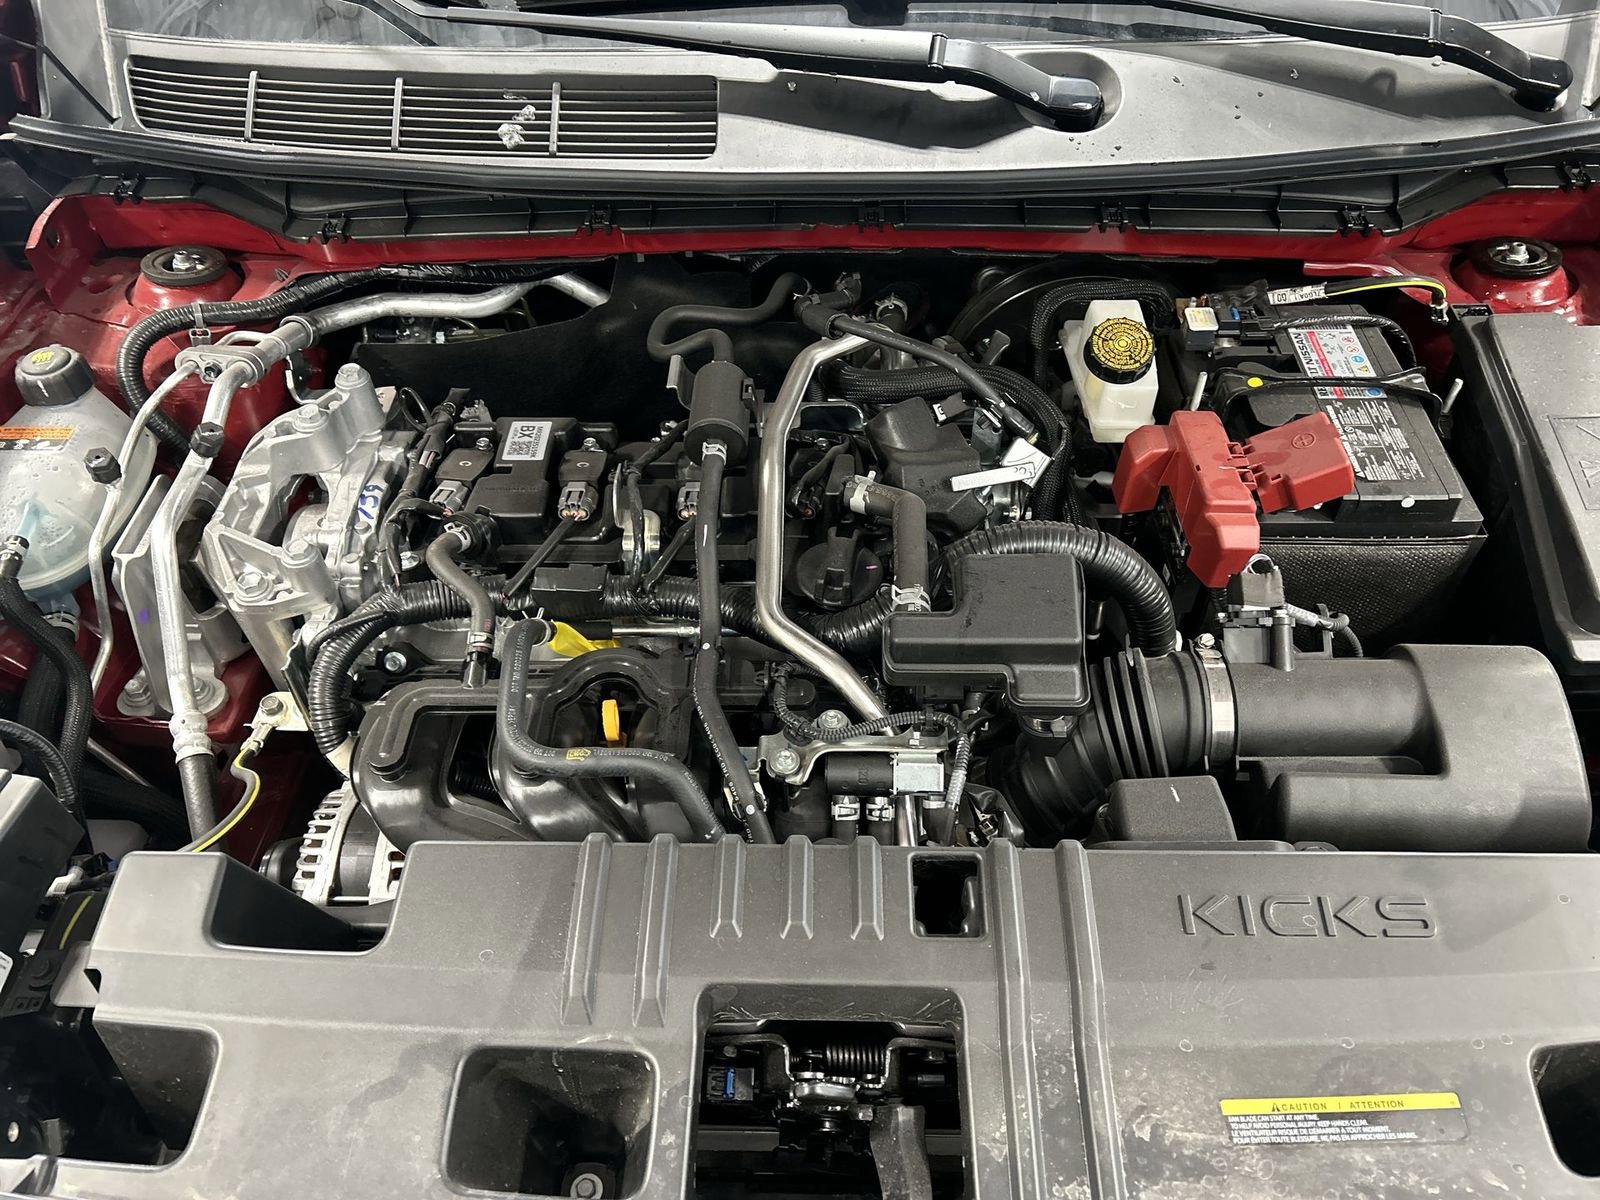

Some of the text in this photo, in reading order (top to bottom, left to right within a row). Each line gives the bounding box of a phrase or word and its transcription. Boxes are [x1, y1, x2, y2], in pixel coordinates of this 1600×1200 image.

[1294, 333, 1314, 365] NISSAN
[518, 425, 536, 439] BX
[1177, 894, 1437, 938] KICKS
[1281, 1100, 1404, 1111] CAUTION ATTENTION
